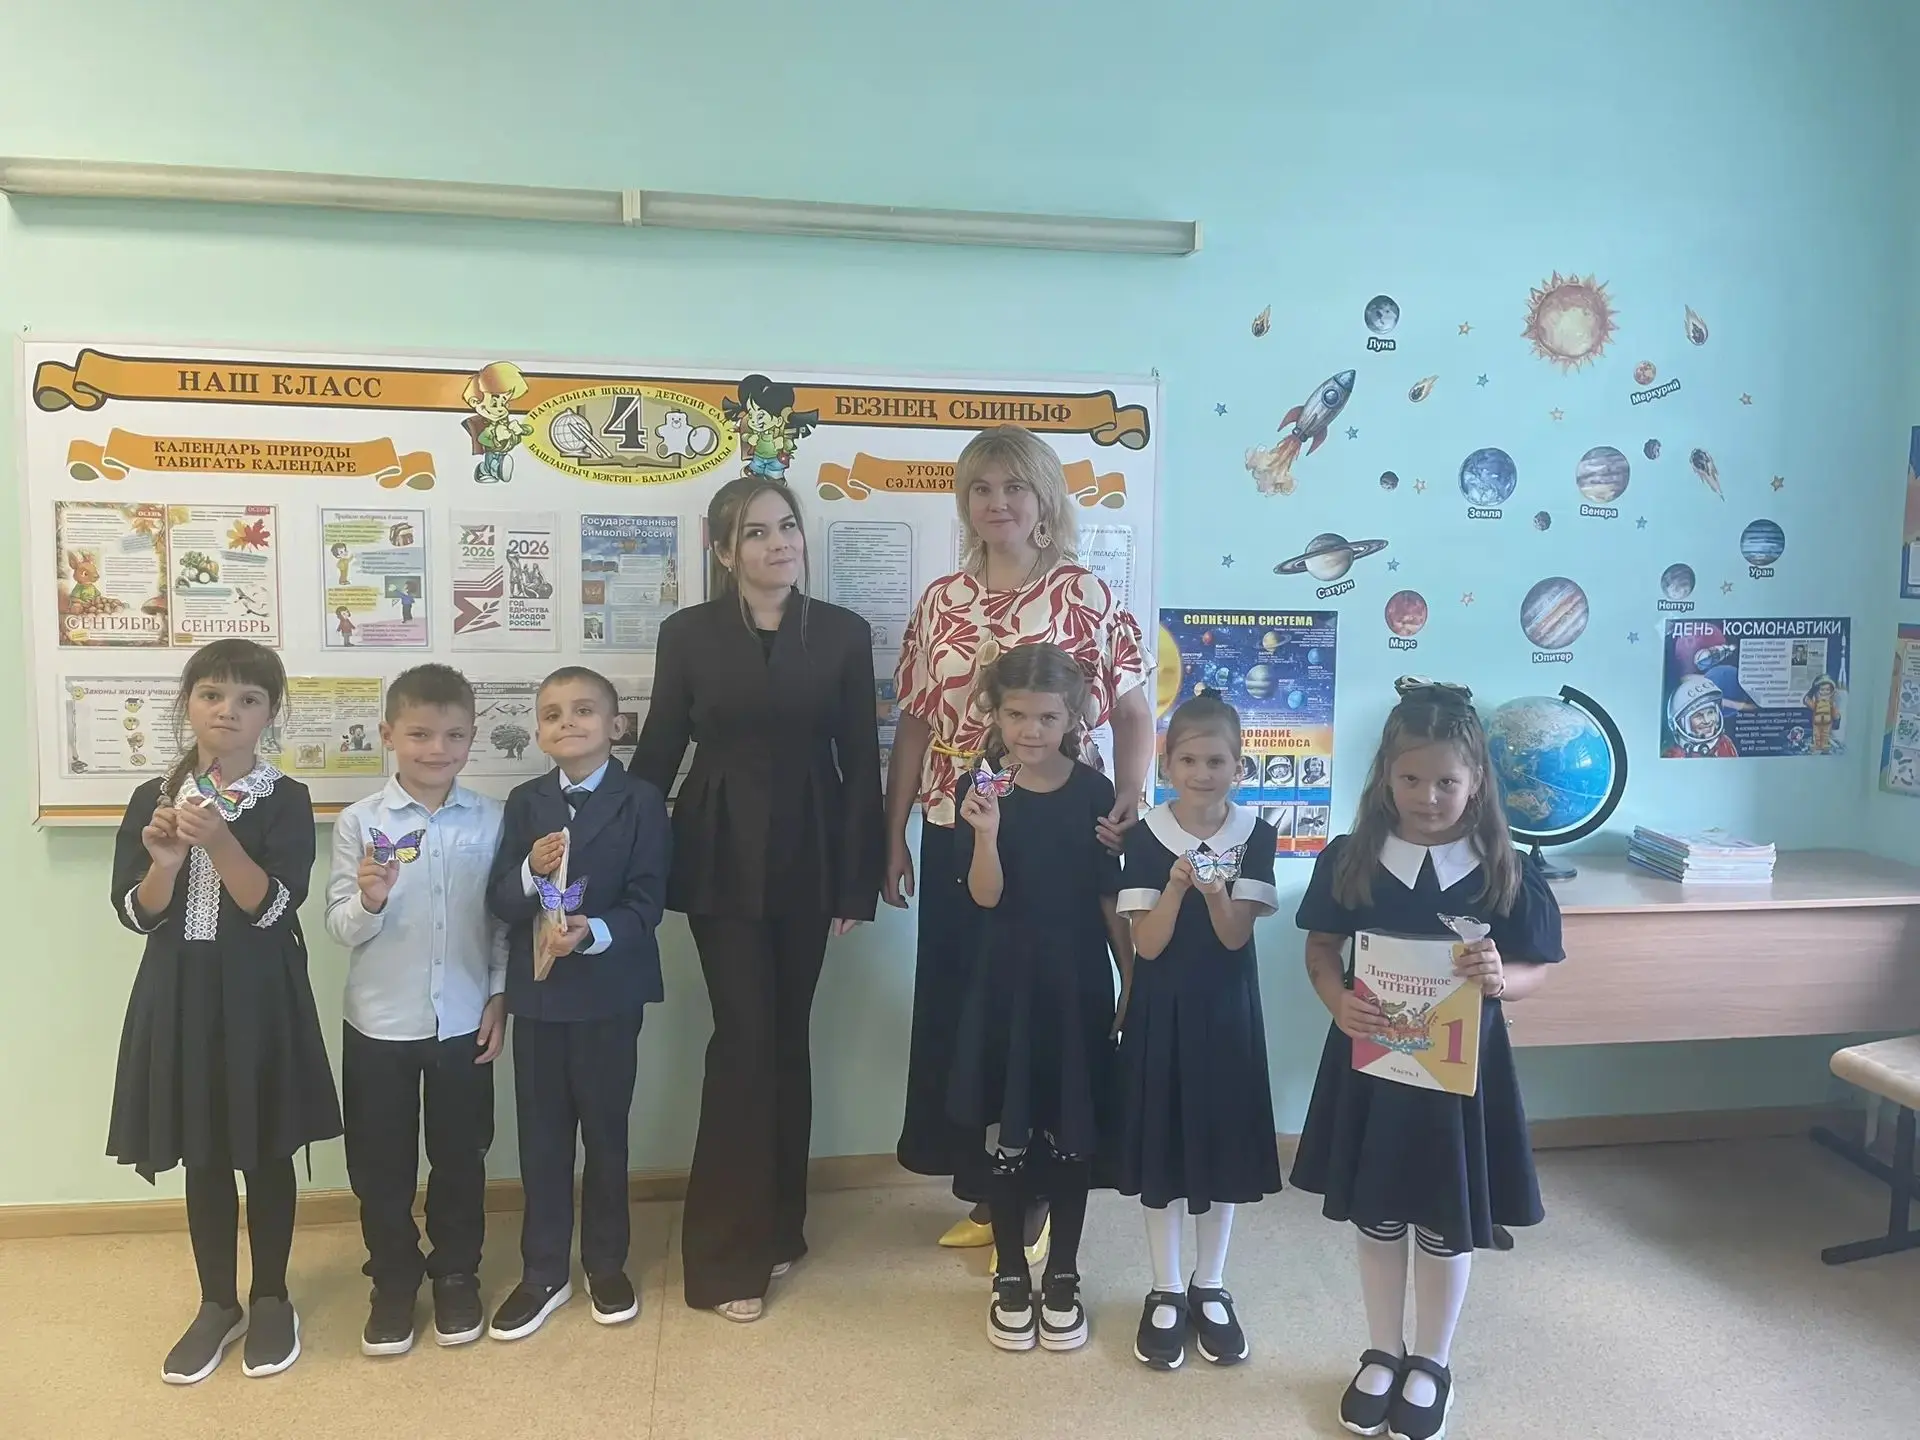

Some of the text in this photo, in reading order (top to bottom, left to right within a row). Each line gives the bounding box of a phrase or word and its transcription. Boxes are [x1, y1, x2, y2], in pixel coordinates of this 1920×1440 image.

[1368, 338, 1396, 351] Луна
[178, 370, 382, 398] НАШ КЛАСС
[1631, 380, 1680, 404] Меркурий
[529, 387, 728, 425] НАЧАЛЬНАЯ ШКОЛА ДЕТСКИЙ САД
[600, 394, 648, 453] 4
[154, 441, 351, 459] КАЛЕНДАРЬ ПРИРОДЫ
[155, 456, 357, 474] ТАБИГАТЬ КАЛЕНДАРЕ
[529, 443, 590, 478] БАШЛАНГЫЧ
[641, 469, 688, 484] БАЛАЛАР
[690, 447, 733, 476] БАКЧАСЫ
[906, 464, 955, 477] УГОЛО
[885, 477, 954, 490] СӘЛАМӘТ
[1468, 508, 1502, 518] Земля
[1581, 505, 1618, 518] Венера
[582, 516, 677, 528] Государственные
[582, 528, 672, 538] символы России
[462, 546, 495, 557] 2026
[508, 539, 550, 555] 2026
[1750, 566, 1774, 579] Уран
[1317, 579, 1355, 599] Сатурн
[509, 600, 525, 608] ГОД
[1658, 600, 1694, 612] Нептун
[66, 615, 161, 631] СЕНТЯБРЬ
[181, 619, 271, 633] СЕНТЯБРЬ
[1183, 614, 1313, 627] СОЛНЕЧНАЯ СИСТЕМА
[1672, 620, 1842, 638] ДЕНЬ КОСМОНАВТИКИ
[1390, 638, 1417, 650] Марс
[1532, 652, 1573, 663] Юпитер
[1240, 728, 1292, 740] ДОВАНИЕ
[1254, 738, 1311, 748] КОСМОСА
[1365, 963, 1452, 986] Литературное
[1377, 979, 1438, 998] ЧТЕНИЕ
[1439, 1018, 1468, 1065] 1
